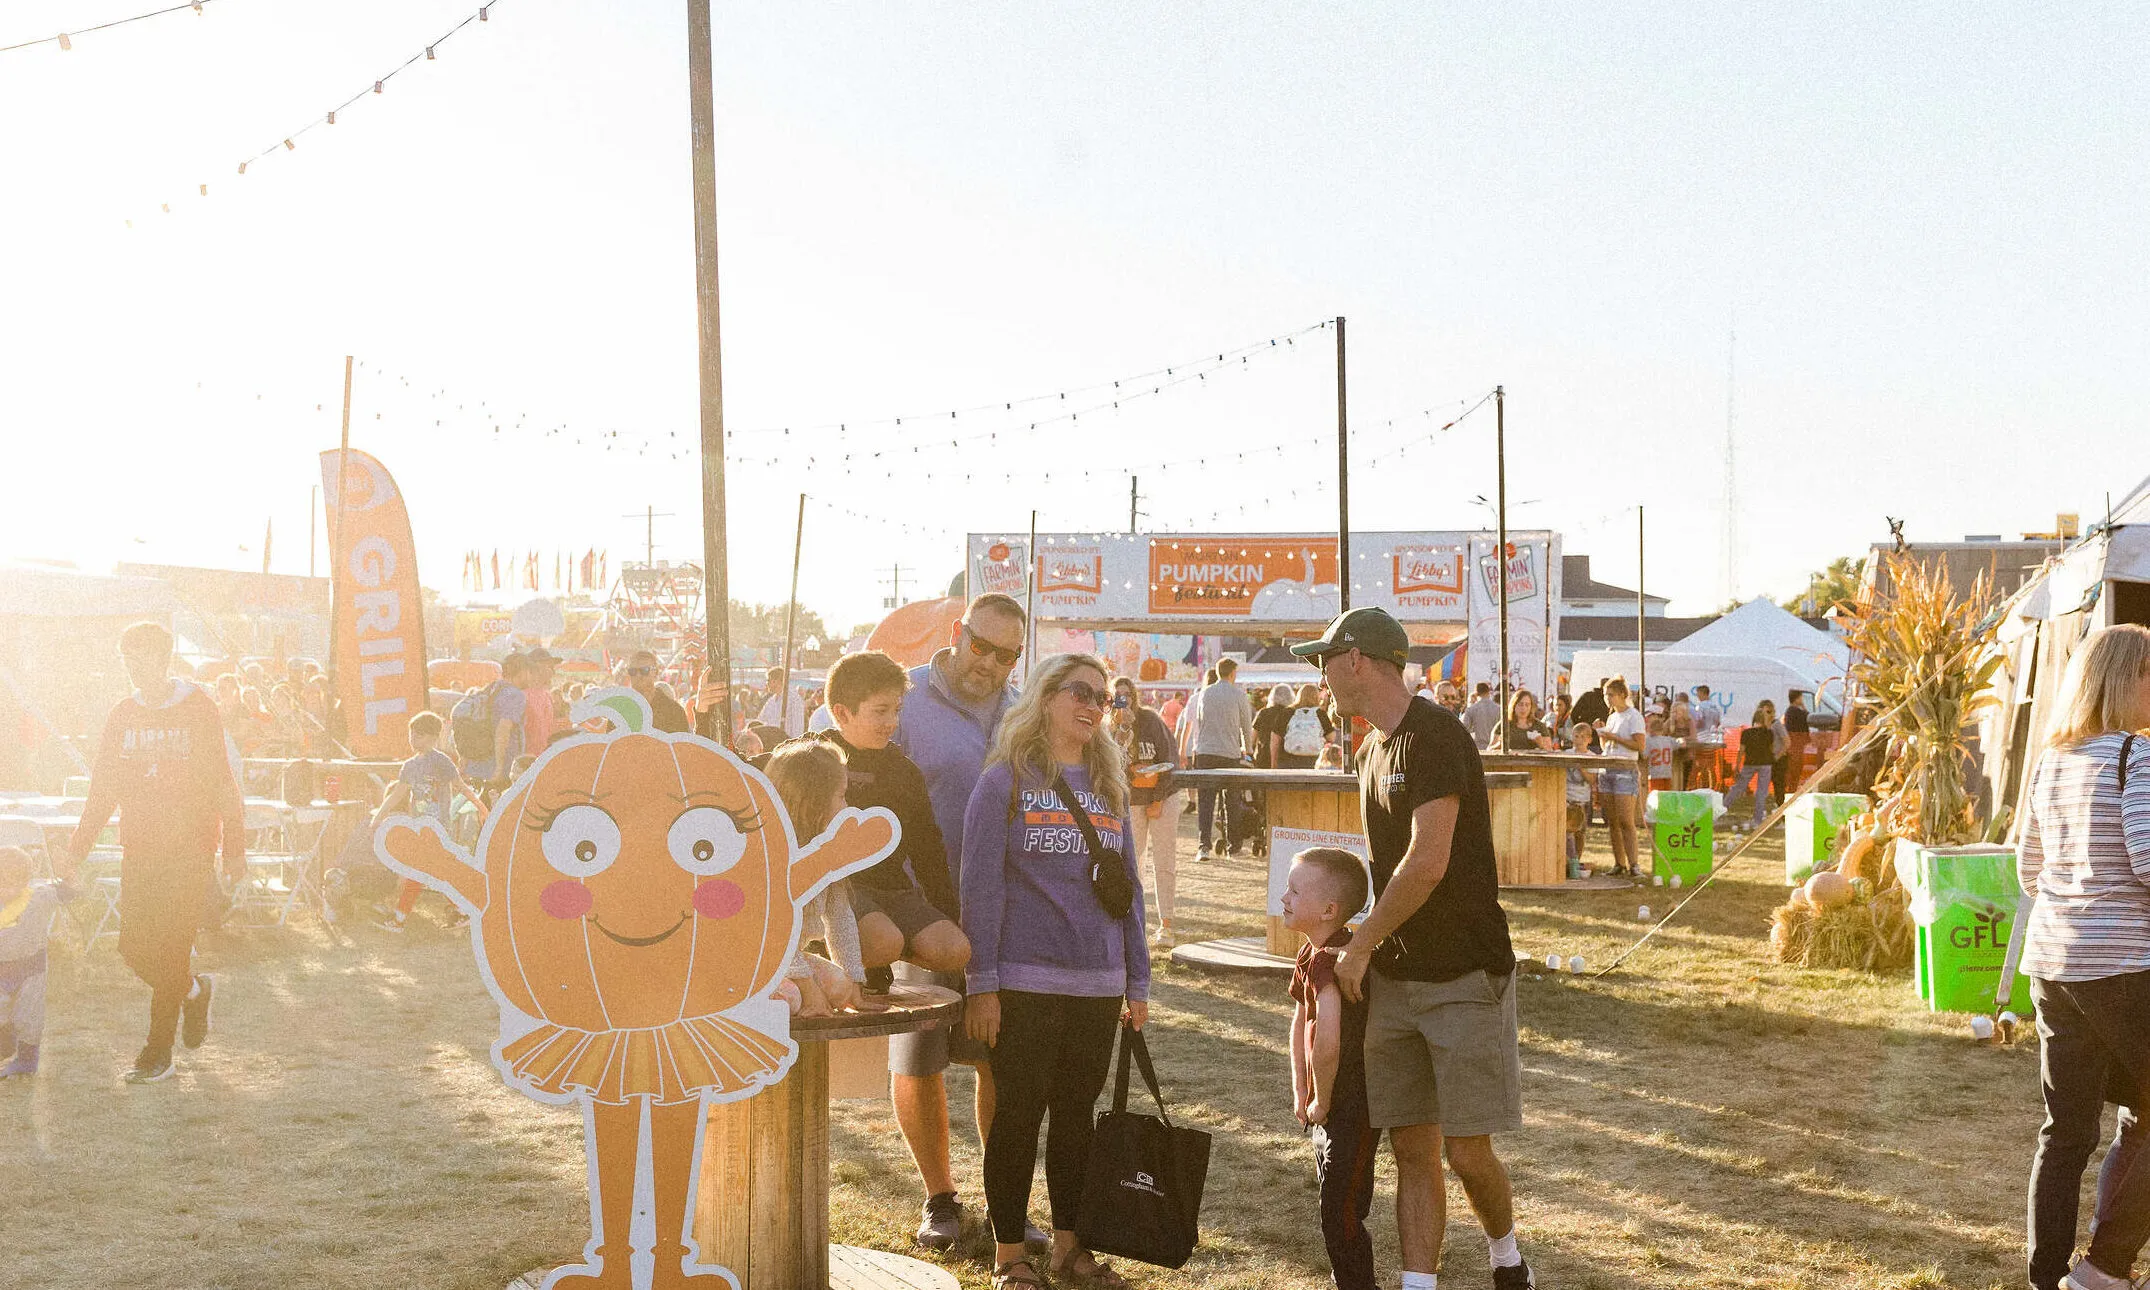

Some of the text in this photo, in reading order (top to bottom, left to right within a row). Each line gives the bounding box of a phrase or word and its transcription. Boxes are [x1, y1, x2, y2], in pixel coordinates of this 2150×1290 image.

[1159, 563, 1264, 583] PUMPKIN
[1407, 559, 1451, 580] Libby's
[1487, 556, 1529, 583] FAMIN'
[1041, 594, 1097, 606] PUMPKIN
[1398, 596, 1458, 608] PUMPKIN
[350, 535, 407, 735] GRILL
[1651, 748, 1671, 766] 20
[1022, 789, 1112, 815] PUPKI
[1274, 829, 1311, 842] GROUNDS
[1312, 833, 1328, 842] LINE
[1667, 830, 1701, 848] GFL
[1950, 920, 2007, 949] GFL
